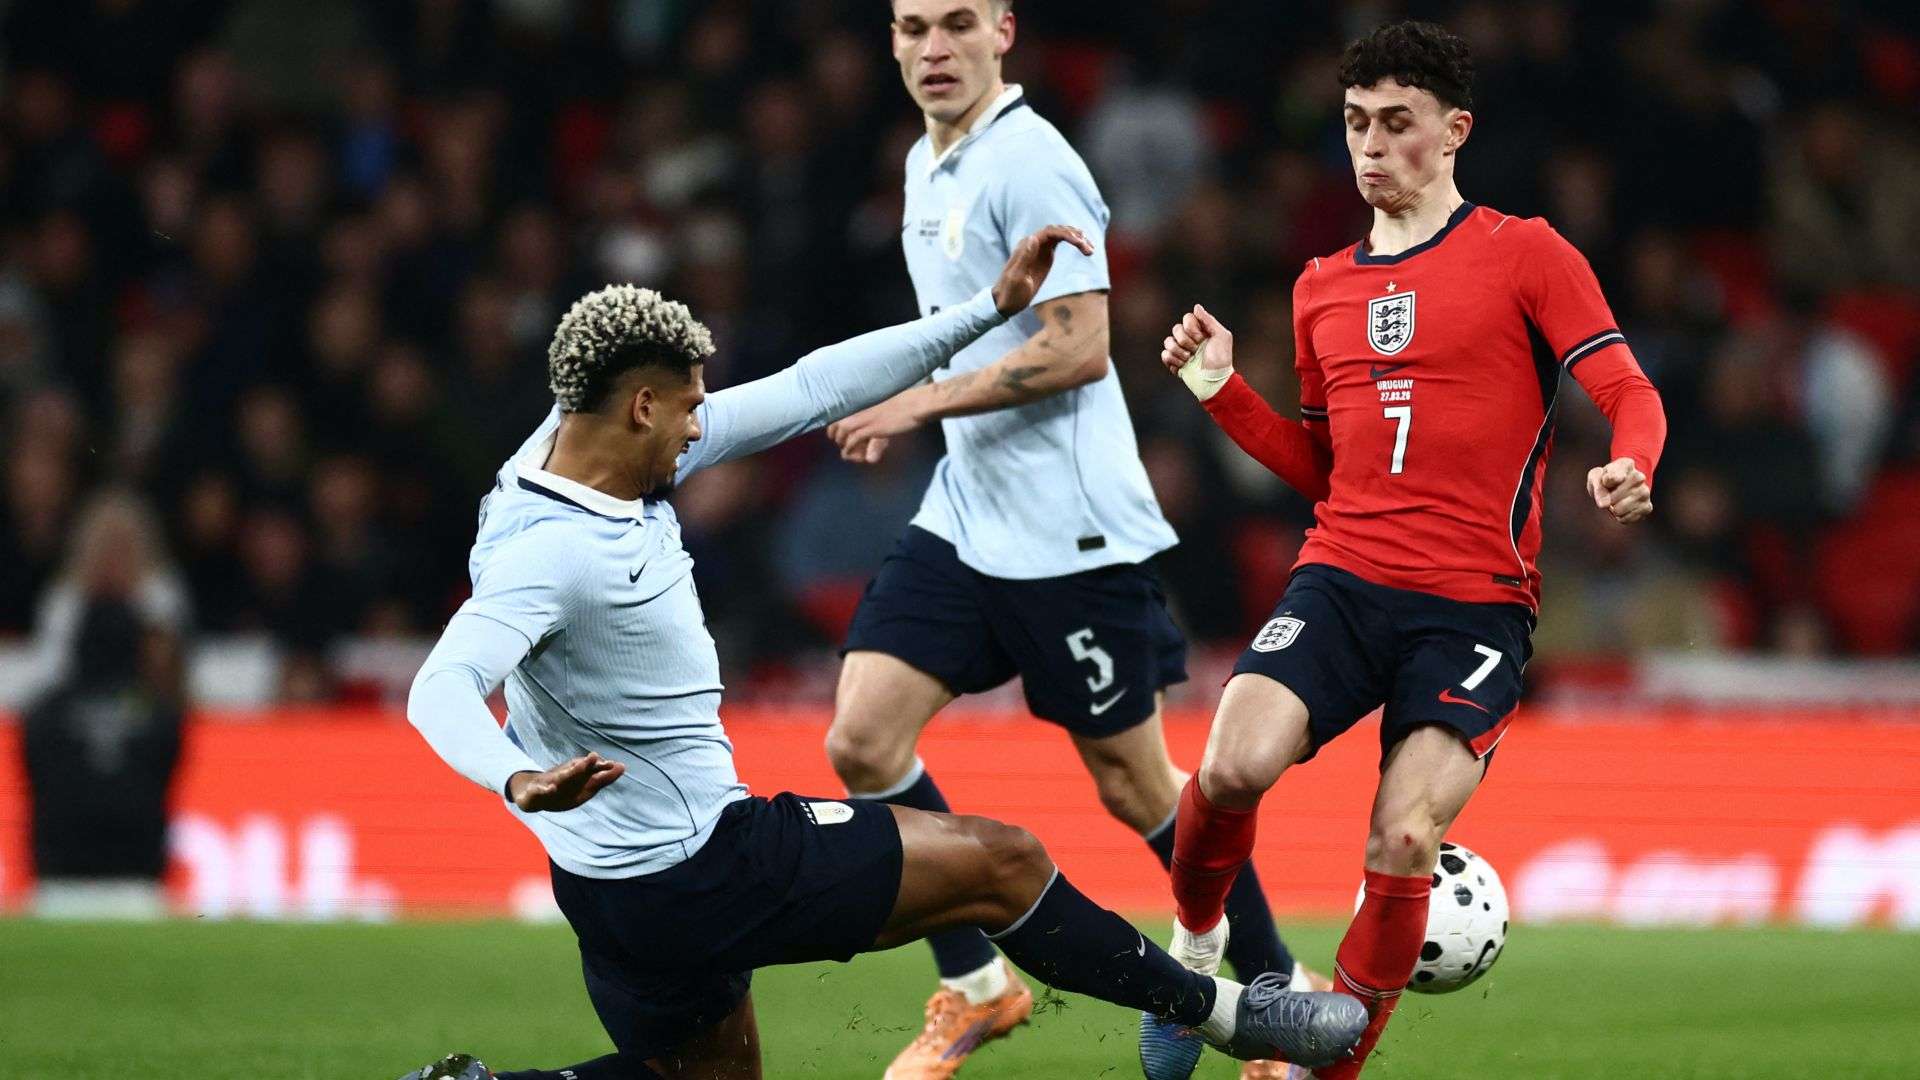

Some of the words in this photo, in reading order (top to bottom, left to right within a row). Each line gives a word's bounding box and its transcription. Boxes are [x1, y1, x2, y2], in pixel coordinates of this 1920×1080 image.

[1376, 379, 1414, 391] URUGUAY
[1383, 405, 1412, 474] 7
[1065, 627, 1114, 693] 5
[1460, 643, 1503, 691] 7
